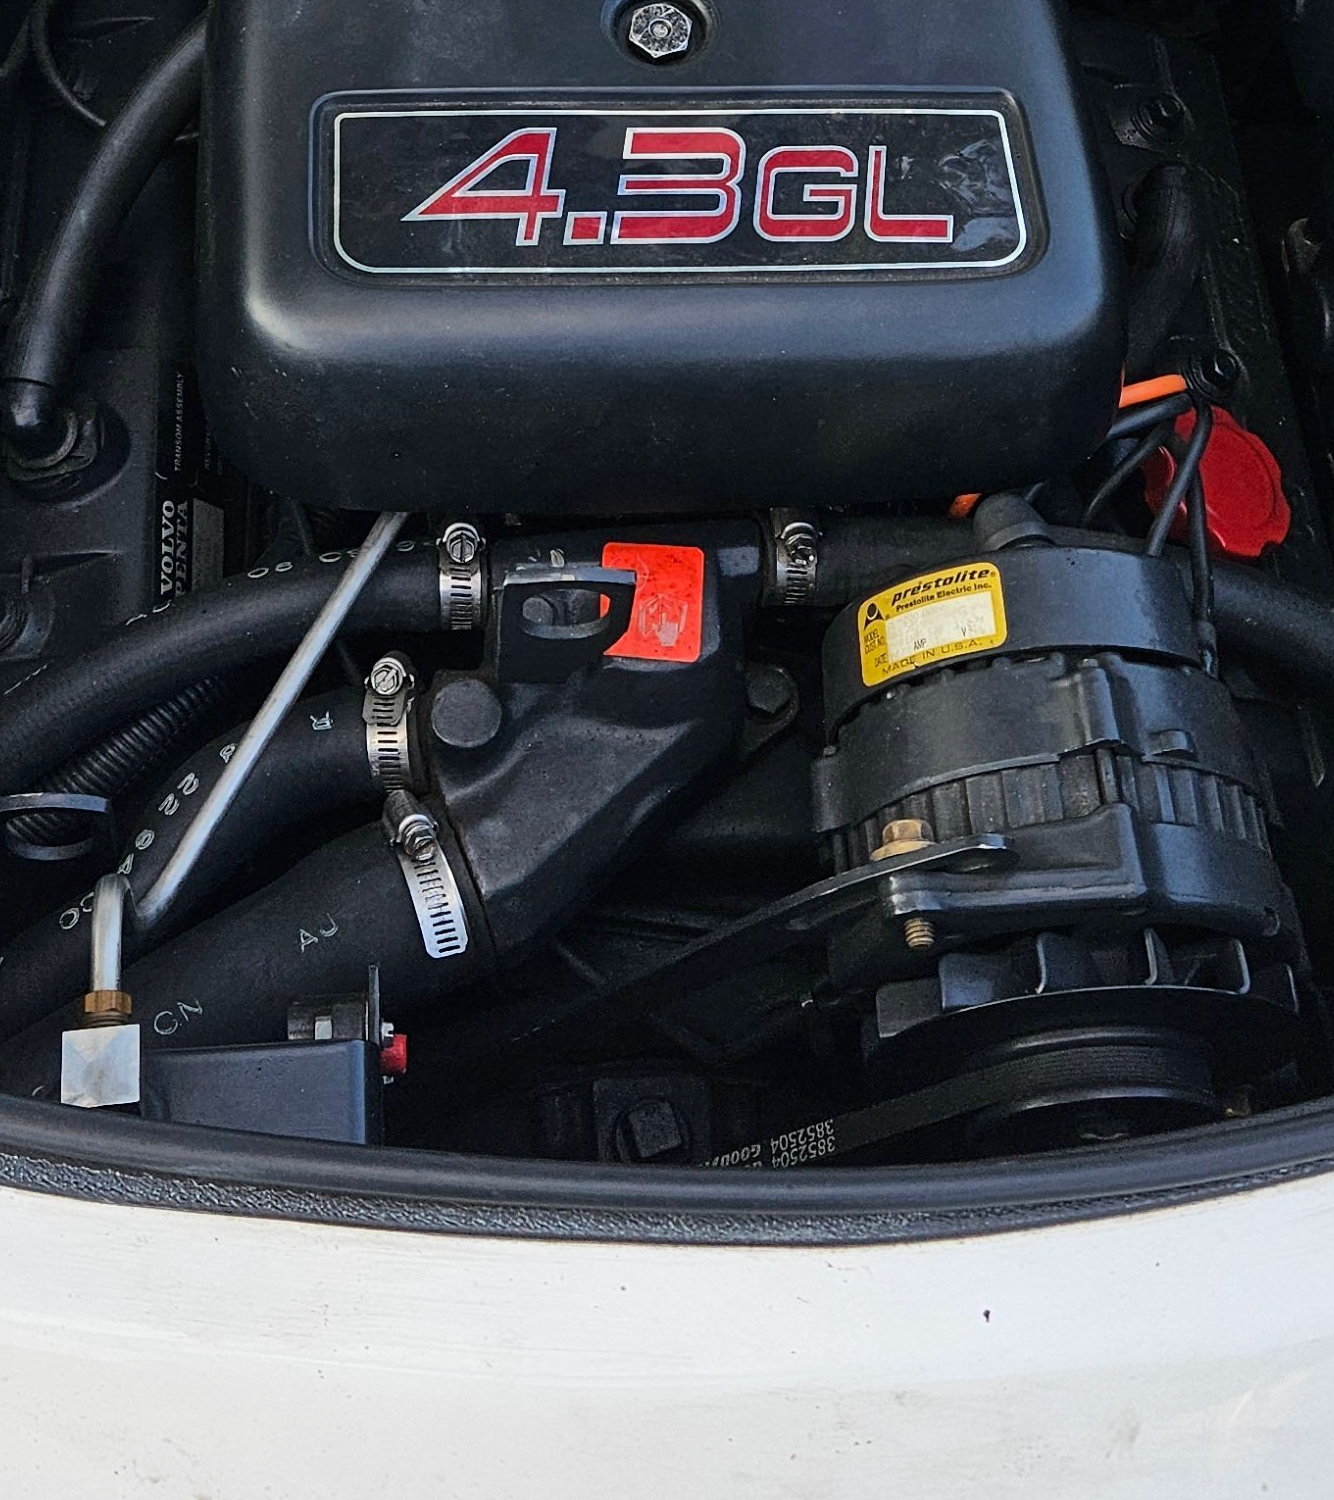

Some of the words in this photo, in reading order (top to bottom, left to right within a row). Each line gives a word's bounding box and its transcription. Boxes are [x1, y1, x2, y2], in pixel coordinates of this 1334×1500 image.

[401, 127, 954, 246] 4.3GL
[174, 371, 186, 423] ASSEMBLY
[173, 424, 184, 472] TRANSOM
[160, 499, 175, 596] VOLVO
[174, 500, 189, 598] PENTA
[896, 593, 935, 613] Prestolite
[937, 585, 972, 599] Electric
[974, 582, 992, 592] Inc.
[882, 655, 916, 676] MADE
[922, 649, 936, 660] IN
[770, 1119, 836, 1154] 3852504
